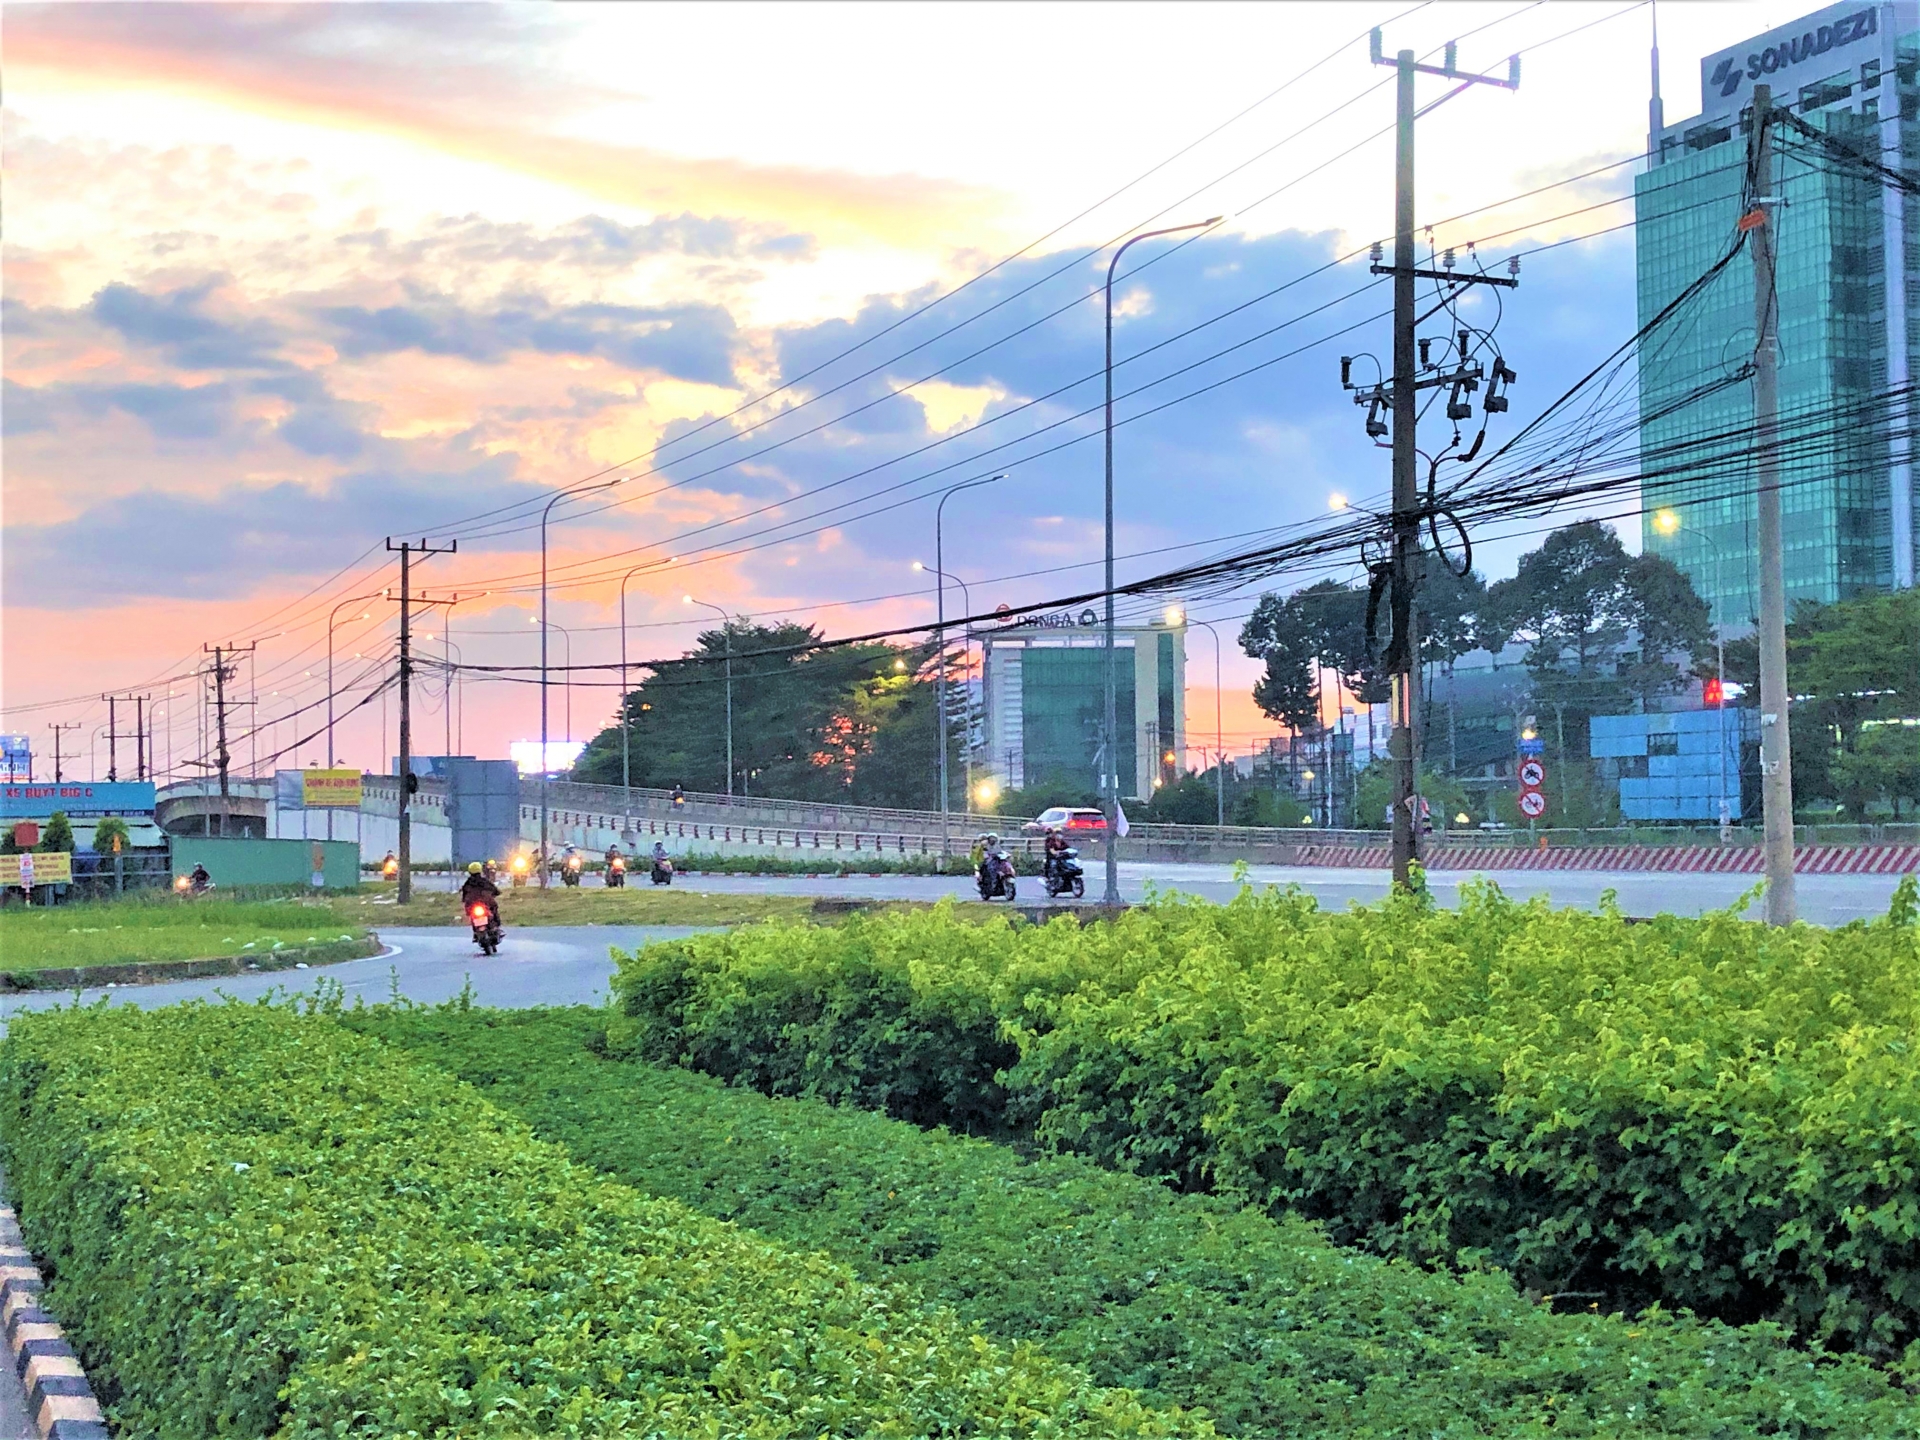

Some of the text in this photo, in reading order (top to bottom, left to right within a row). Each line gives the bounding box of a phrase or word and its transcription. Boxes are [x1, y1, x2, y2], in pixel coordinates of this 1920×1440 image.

[1746, 6, 1877, 80] SONADEZI
[60, 787, 81, 798] BIG
[85, 787, 93, 798] C
